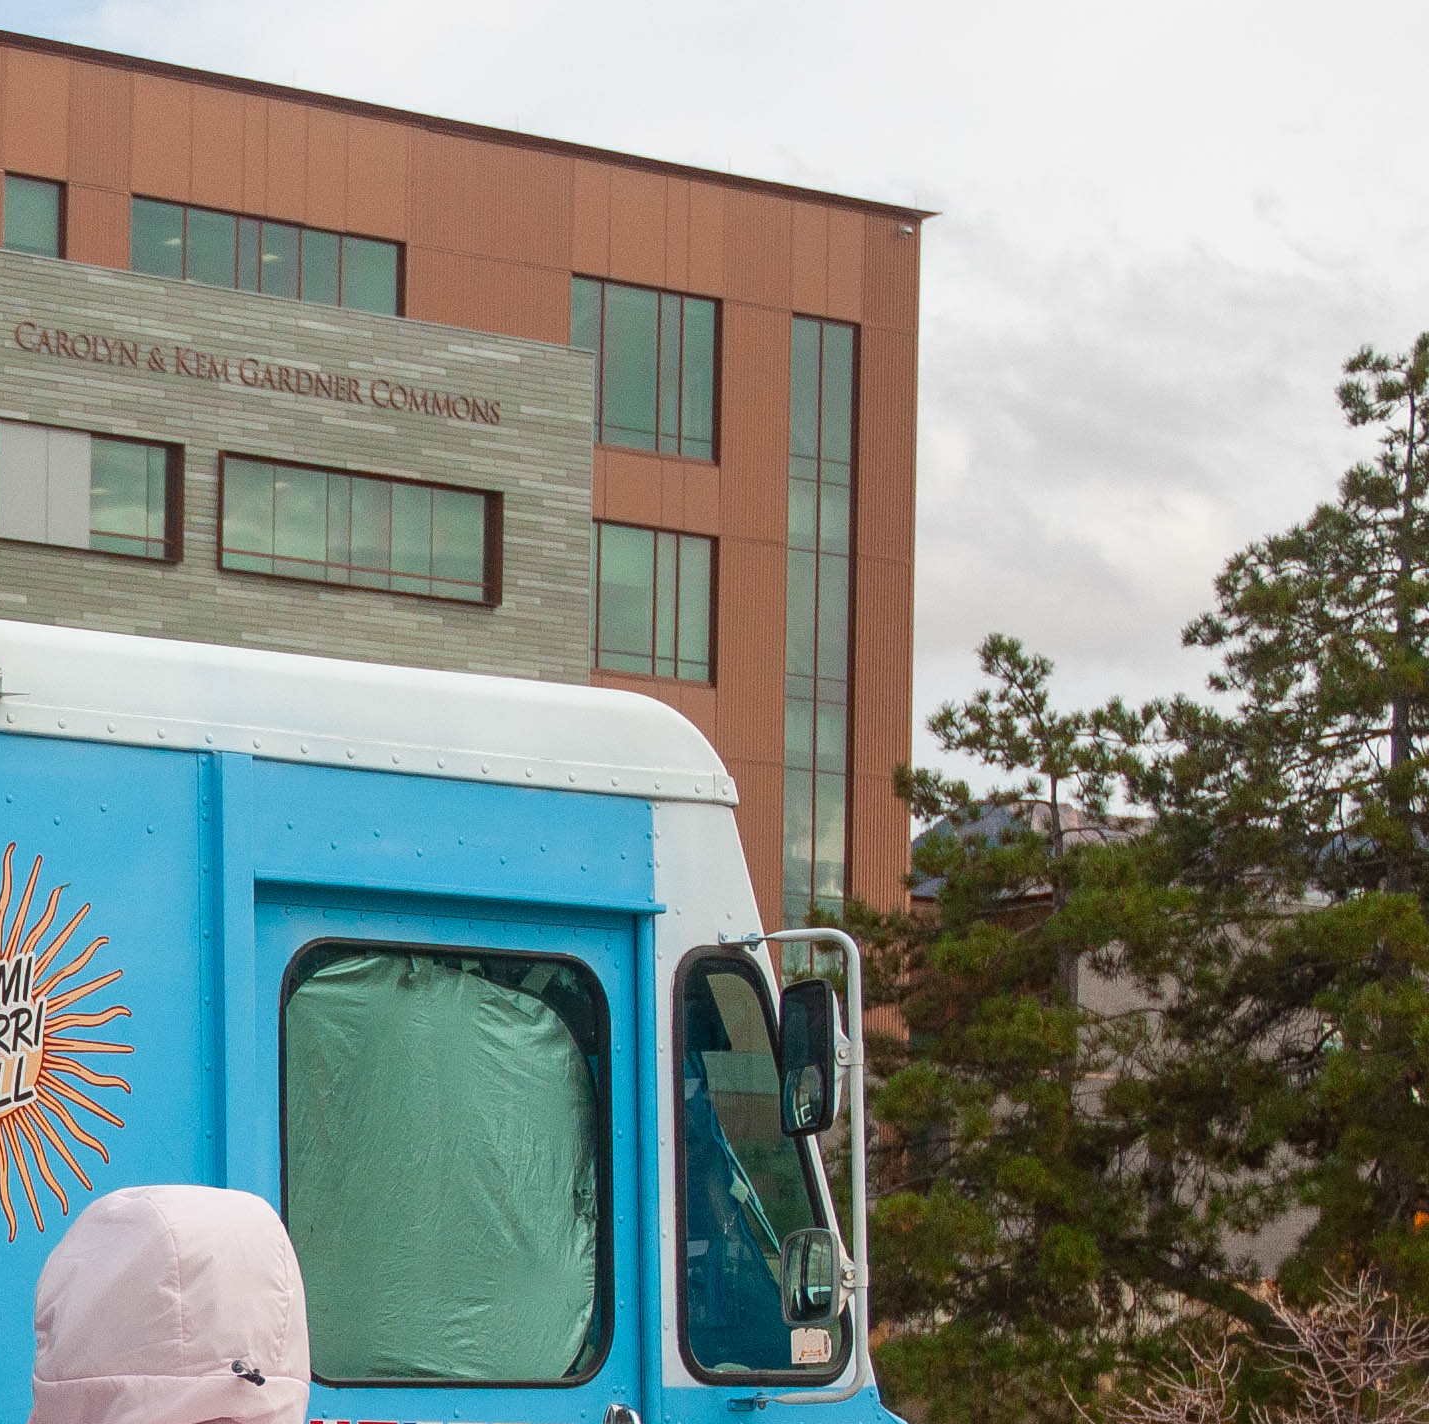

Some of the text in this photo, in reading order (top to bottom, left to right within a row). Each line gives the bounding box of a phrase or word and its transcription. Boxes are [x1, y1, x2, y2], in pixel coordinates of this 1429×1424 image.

[14, 322, 501, 425] CAROLYN & KEM GARDNER COMMONS
